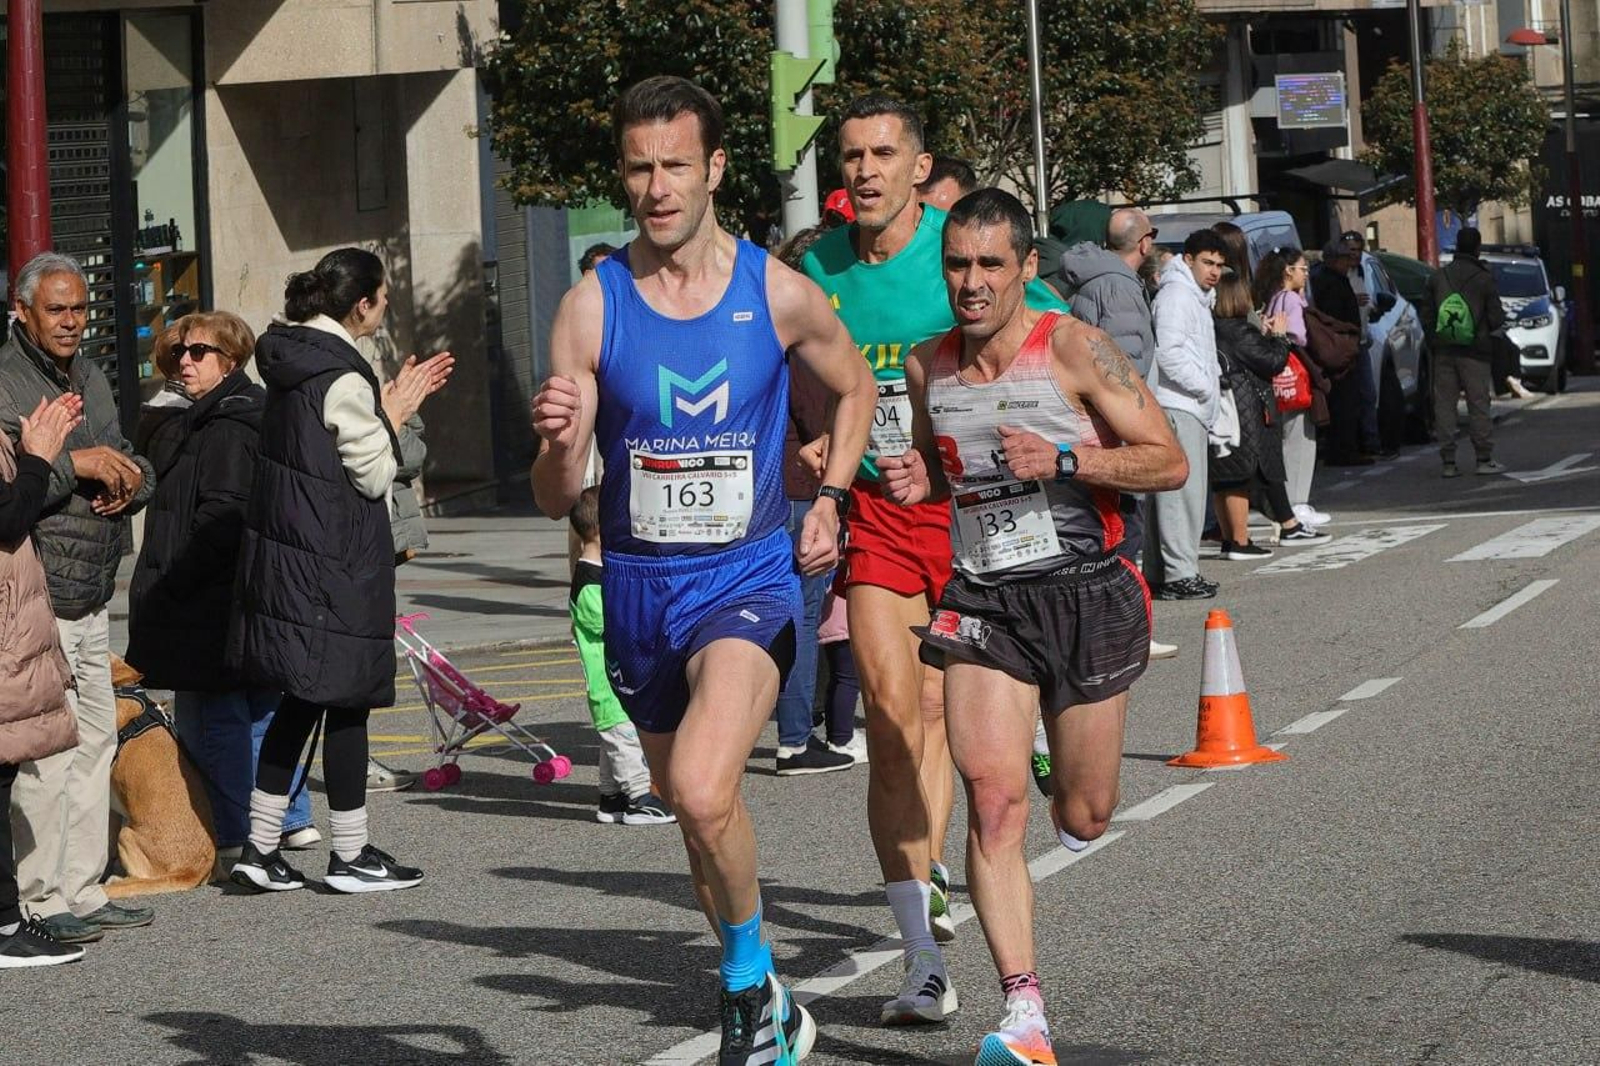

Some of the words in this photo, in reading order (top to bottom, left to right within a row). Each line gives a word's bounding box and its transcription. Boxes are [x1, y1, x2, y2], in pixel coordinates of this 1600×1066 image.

[624, 436, 699, 451] MARINA
[704, 431, 756, 448] MEIRA
[687, 471, 722, 480] CALVARIO
[662, 481, 714, 508] 163
[976, 509, 1017, 539] 133
